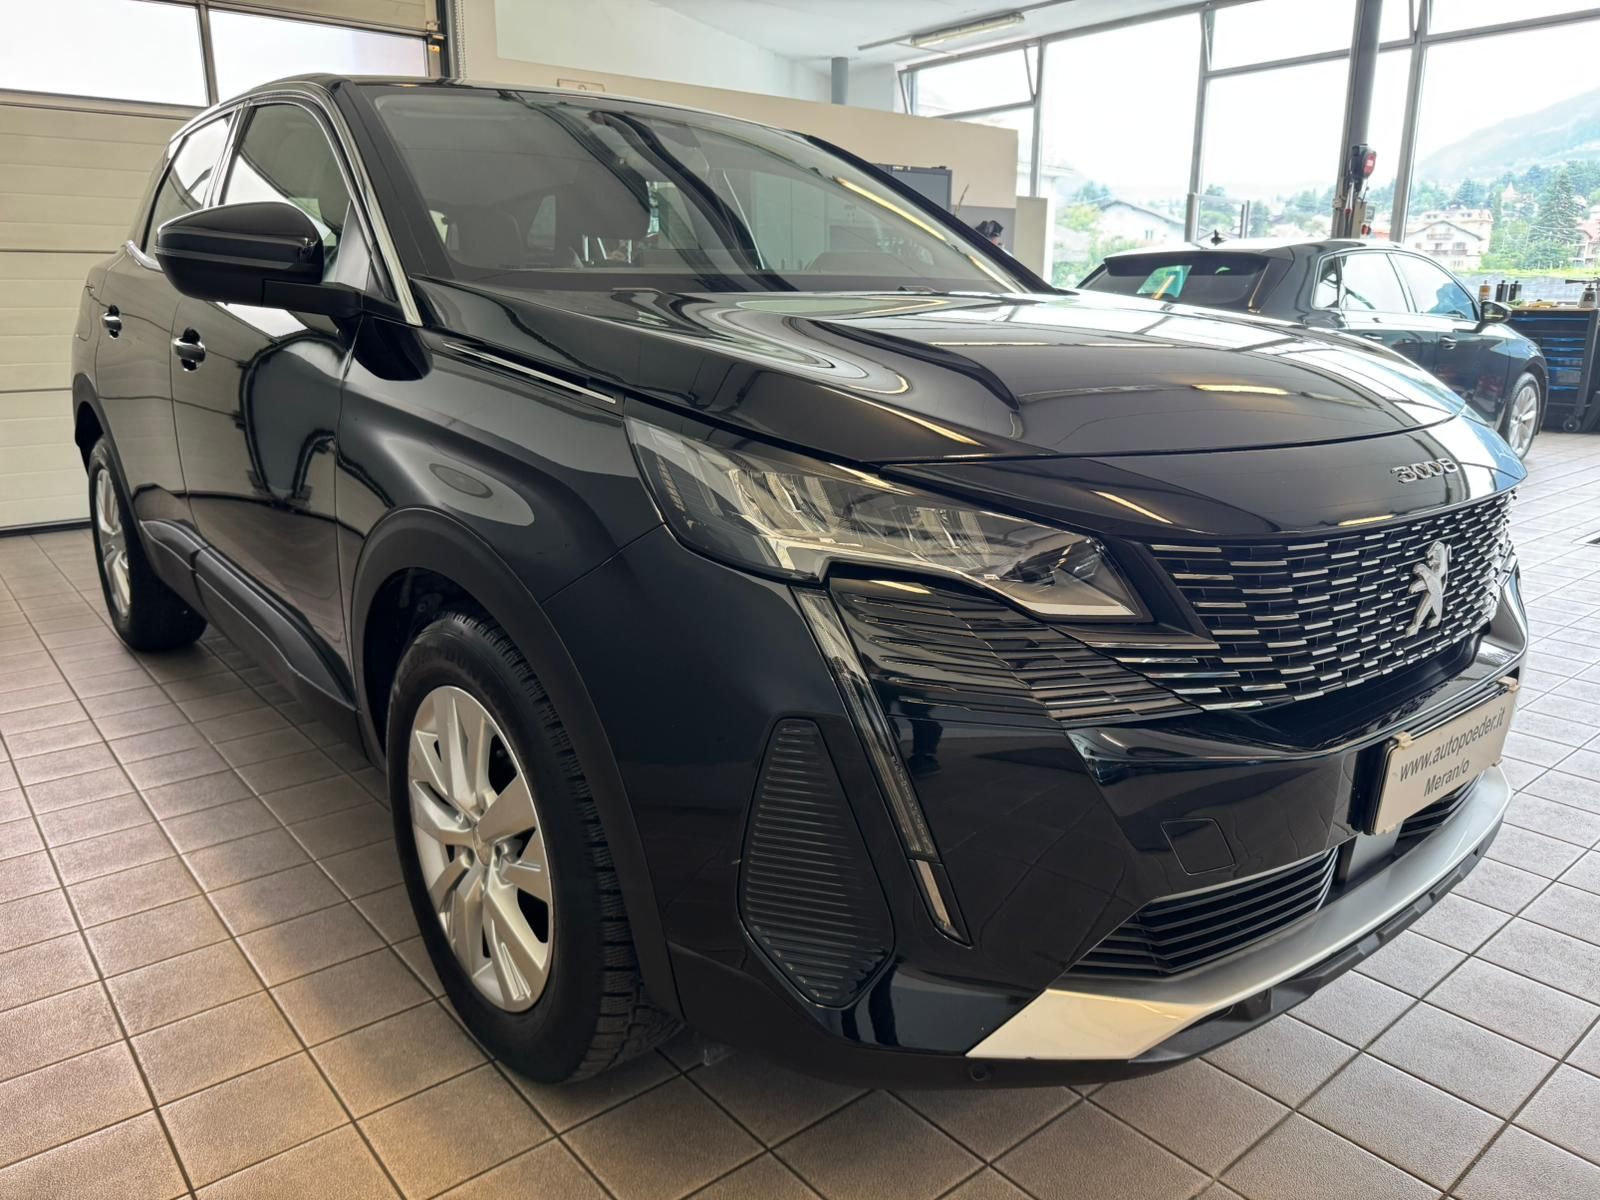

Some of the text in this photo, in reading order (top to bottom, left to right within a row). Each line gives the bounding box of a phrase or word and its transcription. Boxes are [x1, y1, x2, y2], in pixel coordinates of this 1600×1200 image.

[1391, 458, 1458, 483] 3008
[1400, 707, 1505, 782] www.autopoeder.it
[1424, 758, 1470, 797] Meran/o
